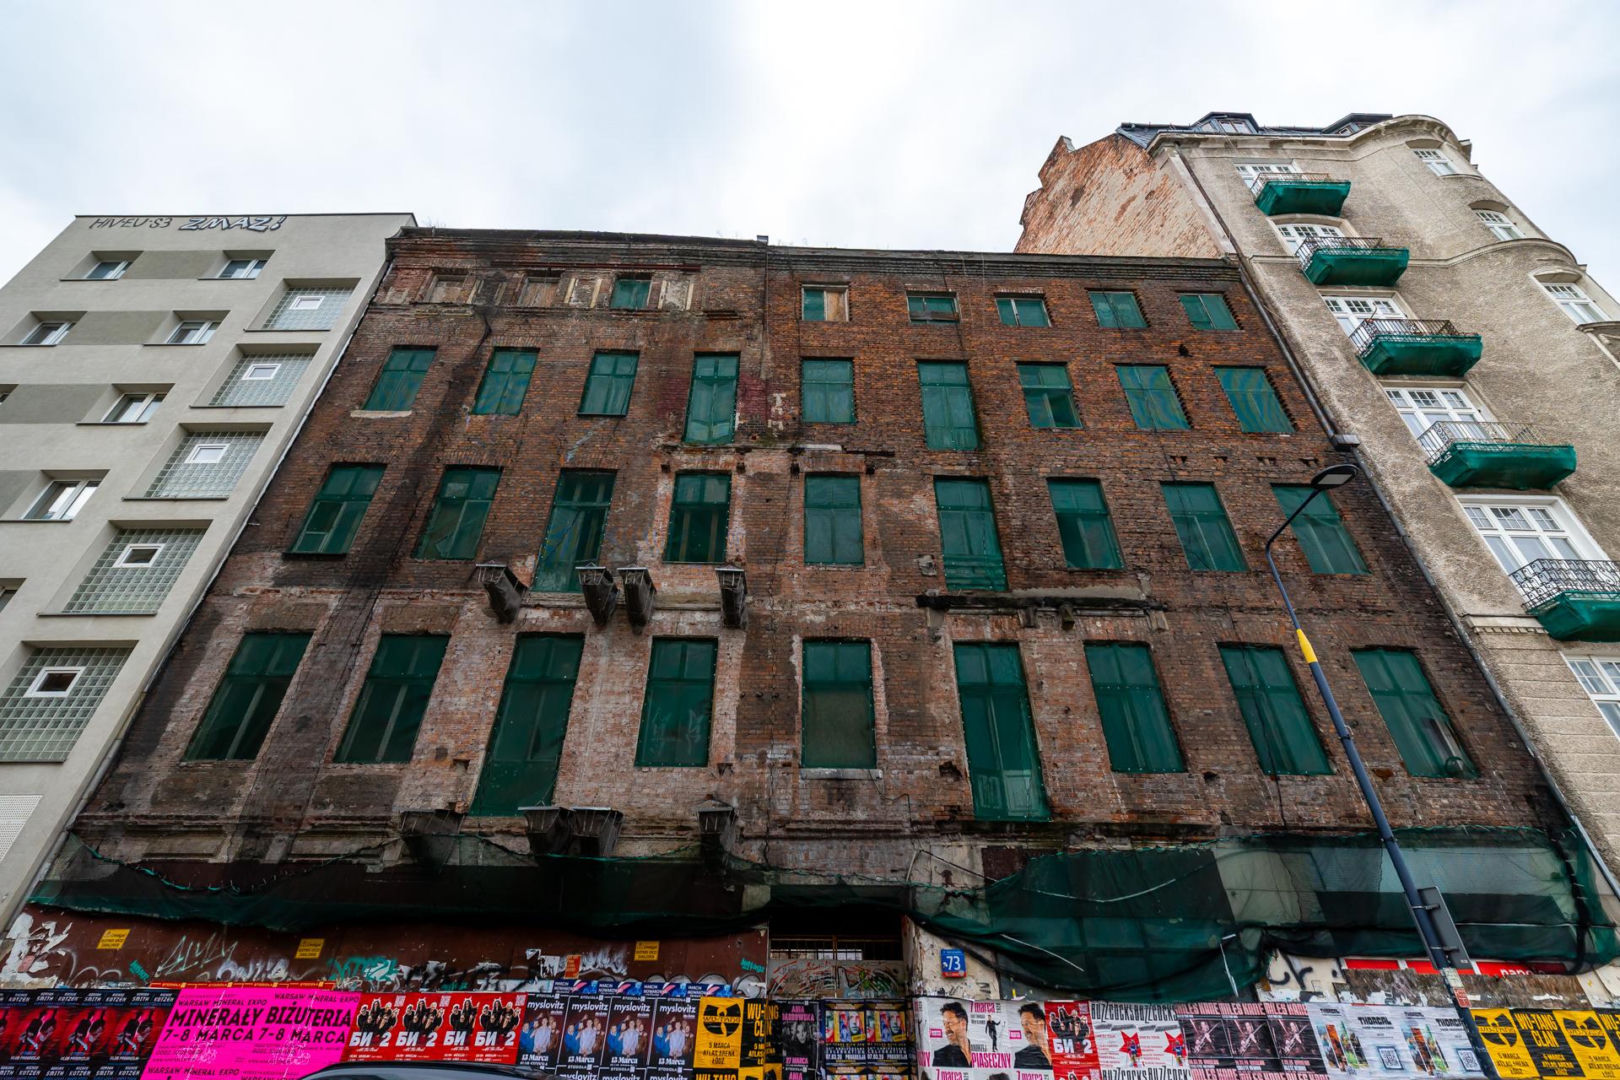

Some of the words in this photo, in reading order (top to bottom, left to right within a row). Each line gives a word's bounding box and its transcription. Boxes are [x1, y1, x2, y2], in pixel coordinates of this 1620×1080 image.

[946, 955, 961, 970] 73
[527, 1000, 564, 1011] myslovitz
[571, 1001, 609, 1014] myslovitz
[613, 1001, 650, 1014] myslovitz
[659, 1003, 696, 1015] myslovitz
[1091, 1002, 1135, 1022] BUZZCOCKS
[170, 1008, 264, 1027] MINERAŁY
[265, 1001, 351, 1027] BIŻUTERIA
[1514, 1013, 1558, 1030] WU-TANG
[163, 1029, 190, 1041] 7-8
[196, 1029, 254, 1041] MARCA
[259, 1028, 285, 1041] 7-8
[291, 1029, 346, 1044] MARCA
[1531, 1030, 1560, 1047] CLAN
[971, 1052, 1011, 1068] PIASECZNY
